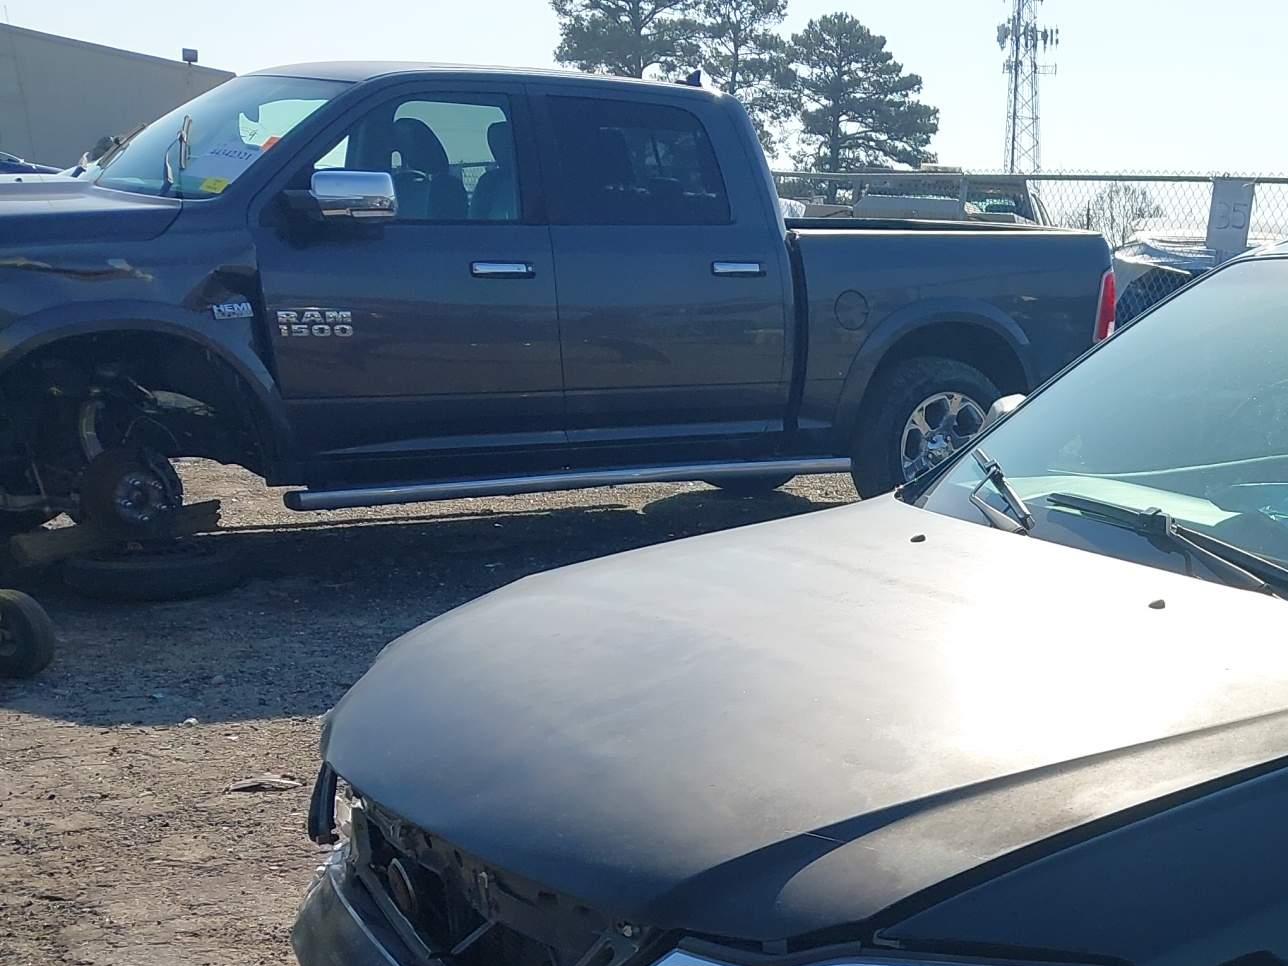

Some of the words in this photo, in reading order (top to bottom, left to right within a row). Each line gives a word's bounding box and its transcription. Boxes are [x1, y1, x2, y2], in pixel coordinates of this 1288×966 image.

[1215, 201, 1249, 230] 35
[212, 302, 251, 313] HEMI
[277, 311, 352, 323] RAM
[278, 324, 354, 337] 1500
